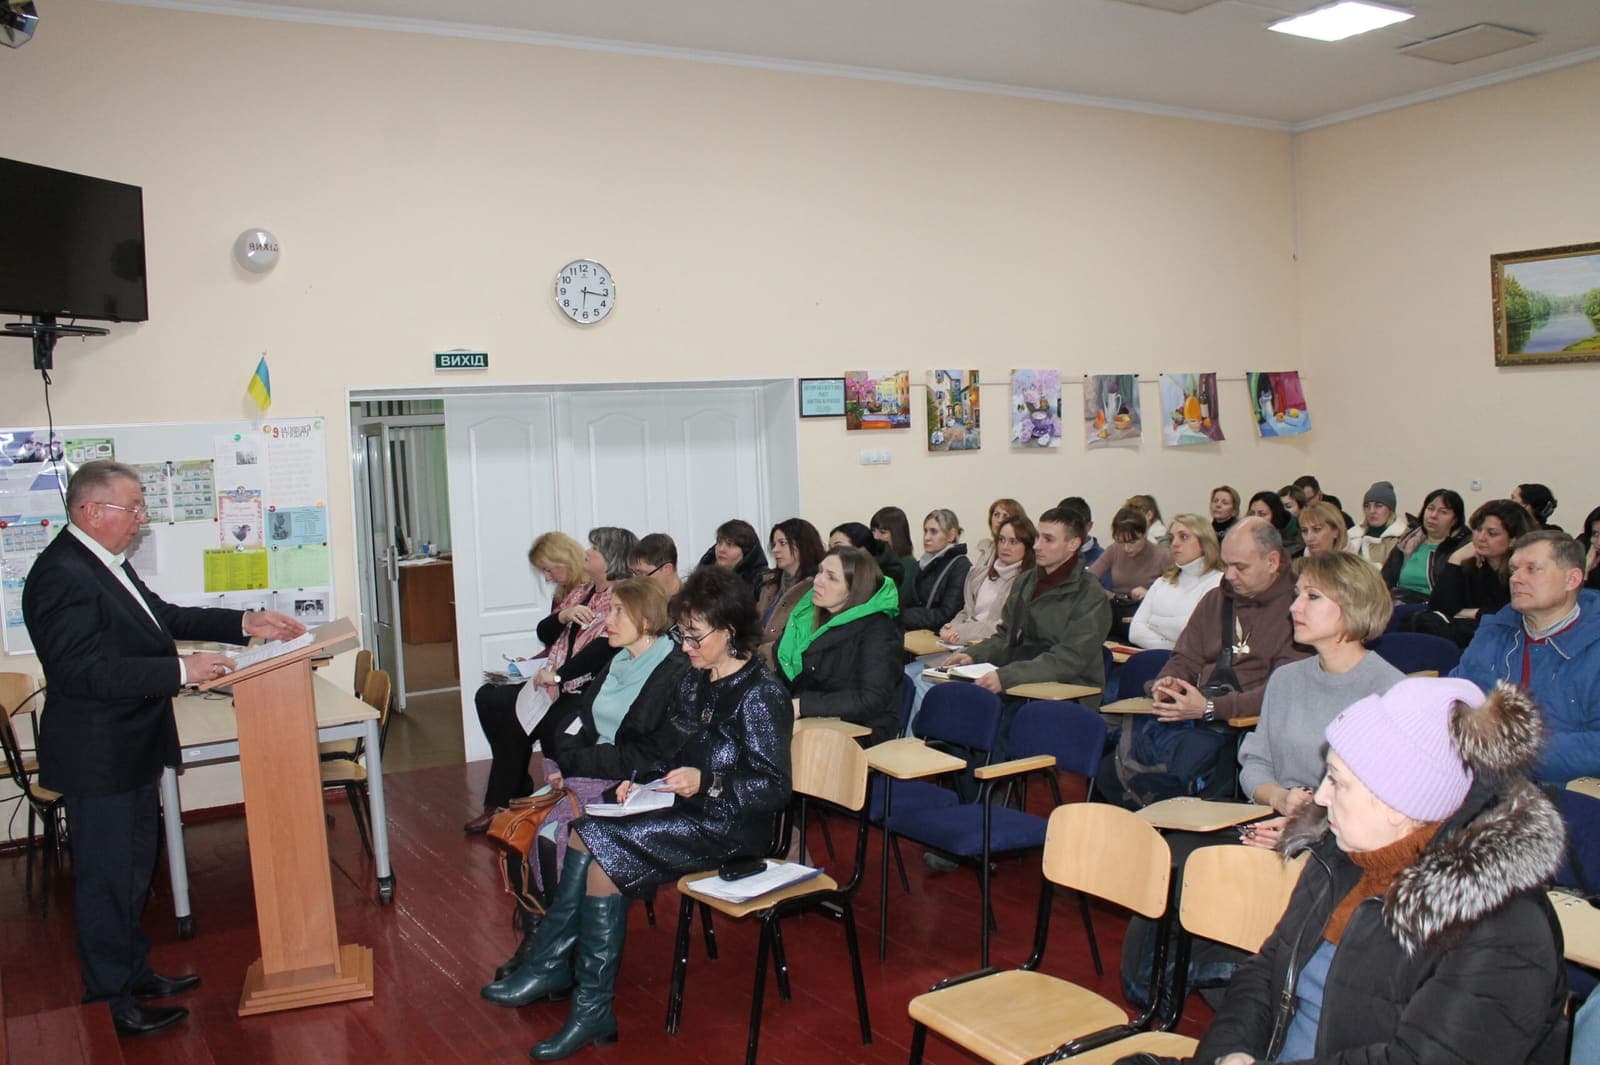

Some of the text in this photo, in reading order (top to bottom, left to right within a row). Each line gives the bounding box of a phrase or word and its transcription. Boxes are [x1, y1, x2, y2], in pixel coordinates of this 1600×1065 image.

[570, 268, 576, 276] 11
[579, 264, 588, 272] 12
[562, 276, 571, 284] 10
[600, 277, 605, 285] 2
[560, 287, 566, 295] 9
[603, 289, 608, 297] 3
[564, 299, 569, 307] 8
[572, 308, 578, 316] 7
[583, 311, 588, 319] 6
[593, 308, 600, 316] 5
[440, 355, 485, 366] ВИХІД
